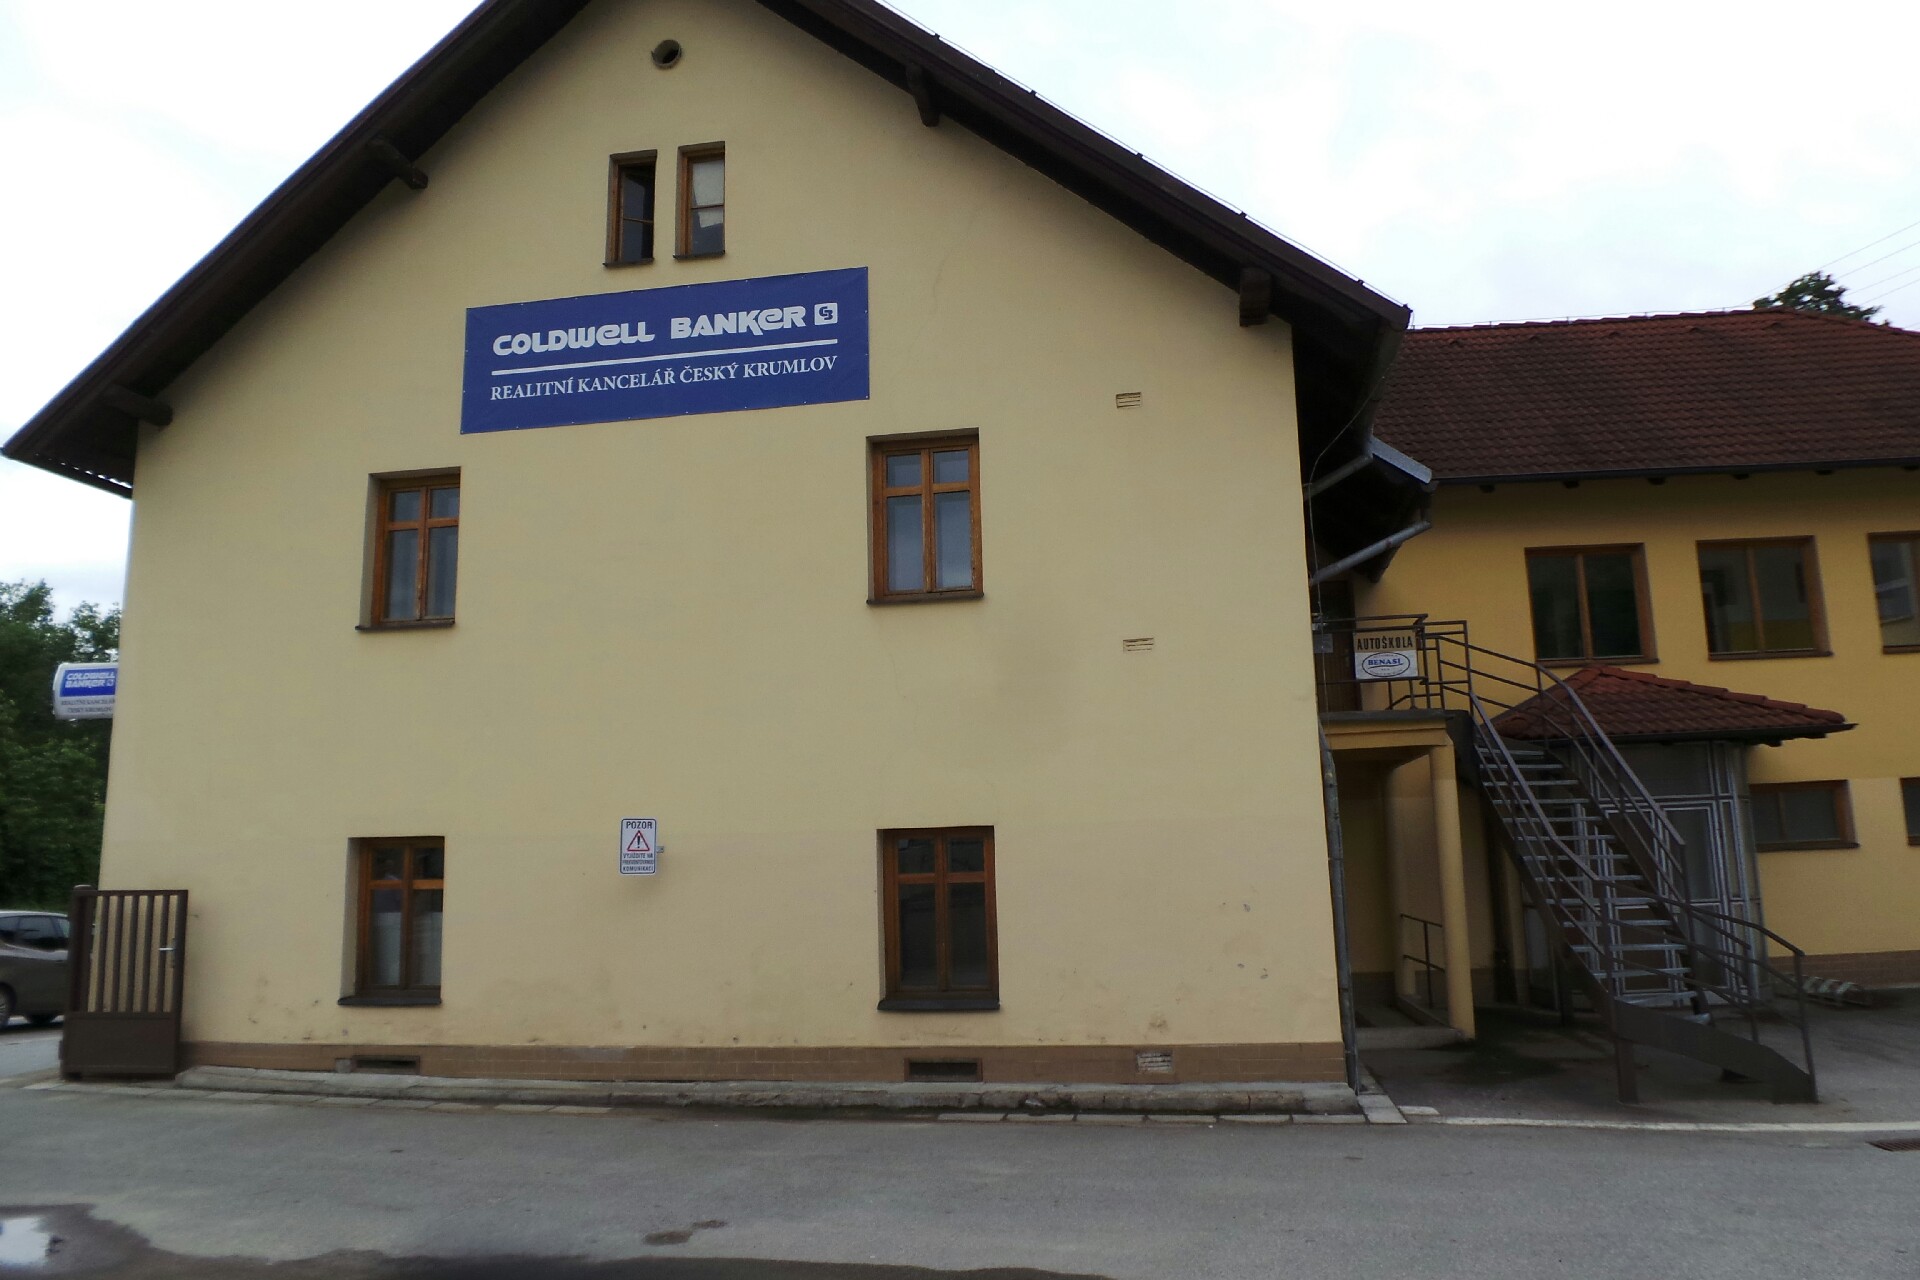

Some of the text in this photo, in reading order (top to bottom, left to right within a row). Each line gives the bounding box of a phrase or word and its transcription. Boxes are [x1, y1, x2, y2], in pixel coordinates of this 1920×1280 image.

[490, 355, 838, 401] REALITNÍ KANCELÁŘ ČESKÝ KRUMLOV
[1357, 635, 1413, 650] AUTOŠKOLA
[626, 821, 653, 829] POZOR
